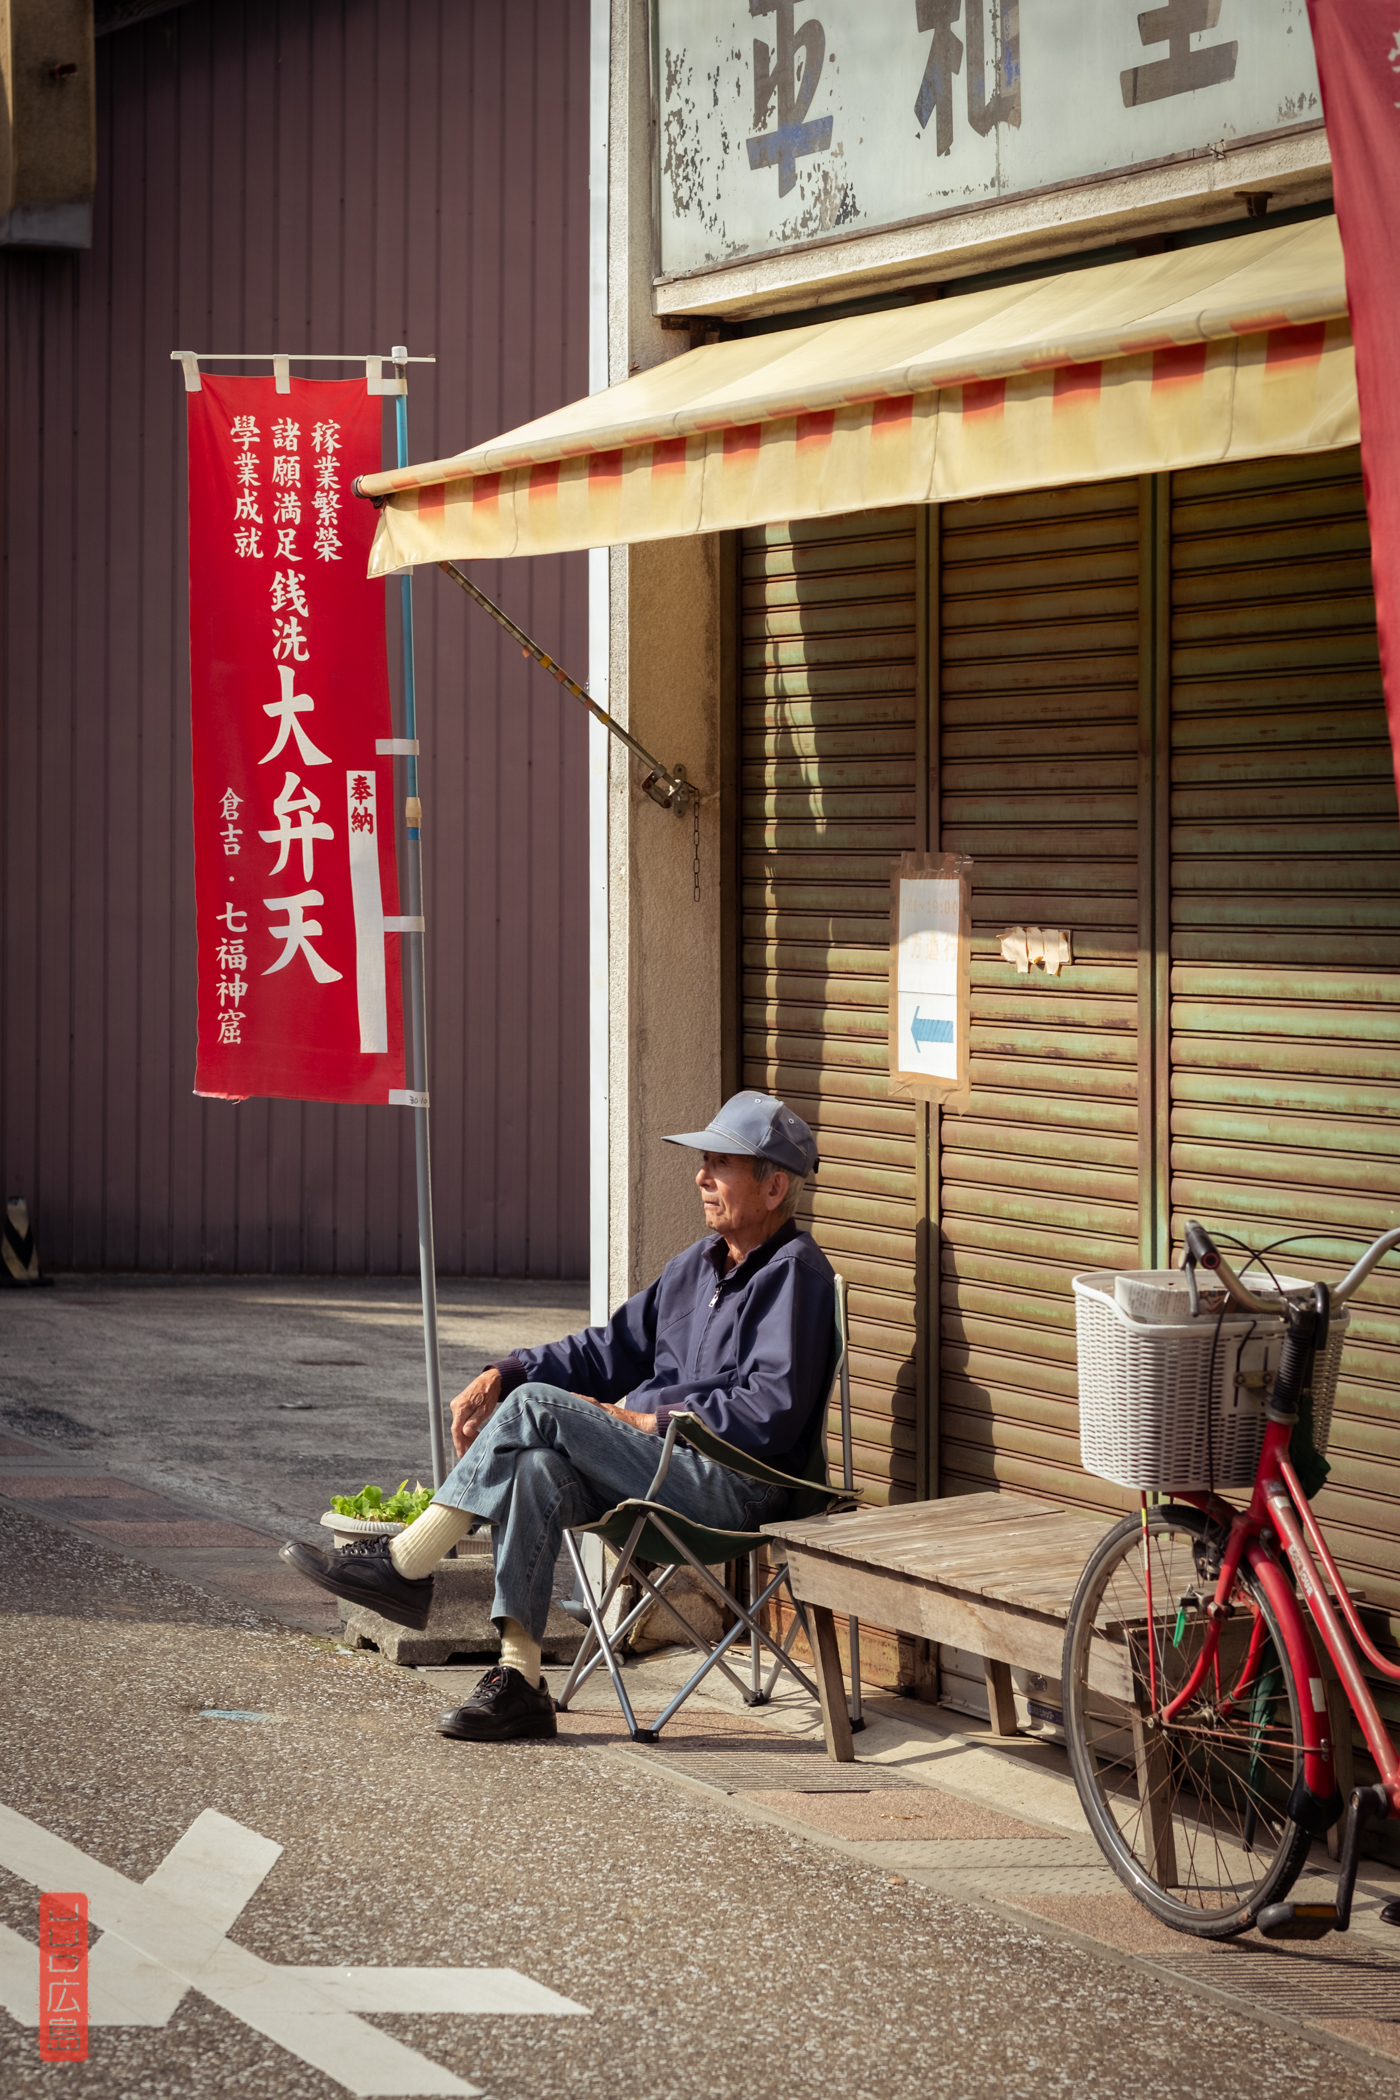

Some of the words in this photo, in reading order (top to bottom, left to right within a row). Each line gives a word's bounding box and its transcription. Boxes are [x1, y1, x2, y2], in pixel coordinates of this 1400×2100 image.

[271, 417, 303, 562] 諸願満足
[350, 774, 375, 836] 奉納
